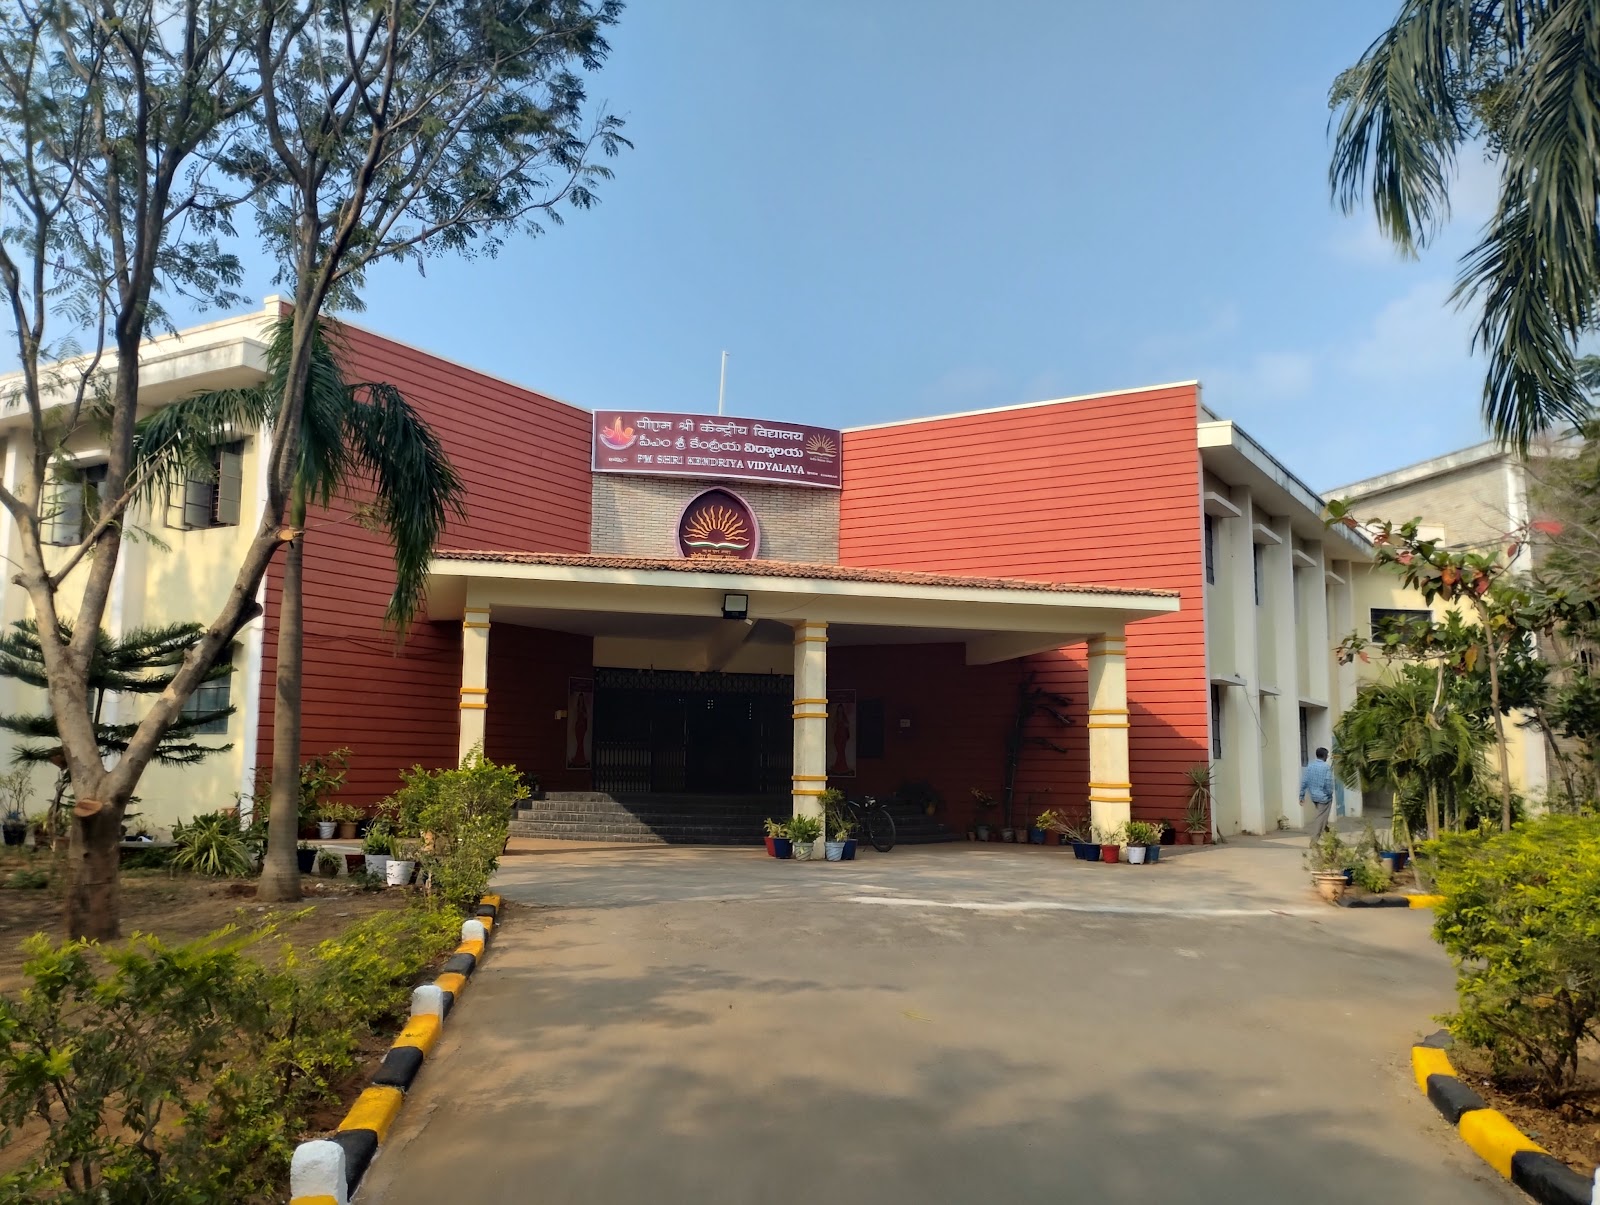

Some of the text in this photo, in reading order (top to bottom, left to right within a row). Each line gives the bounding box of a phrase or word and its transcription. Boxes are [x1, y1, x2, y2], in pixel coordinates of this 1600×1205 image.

[679, 418, 694, 431] श्री
[700, 420, 748, 437] केन्द्रीय
[753, 424, 804, 441] विद्यालय
[638, 454, 653, 463] PM
[657, 455, 683, 464] SHRI
[687, 457, 744, 468] KENDRIYA
[747, 461, 805, 474] VIDYALAYA
